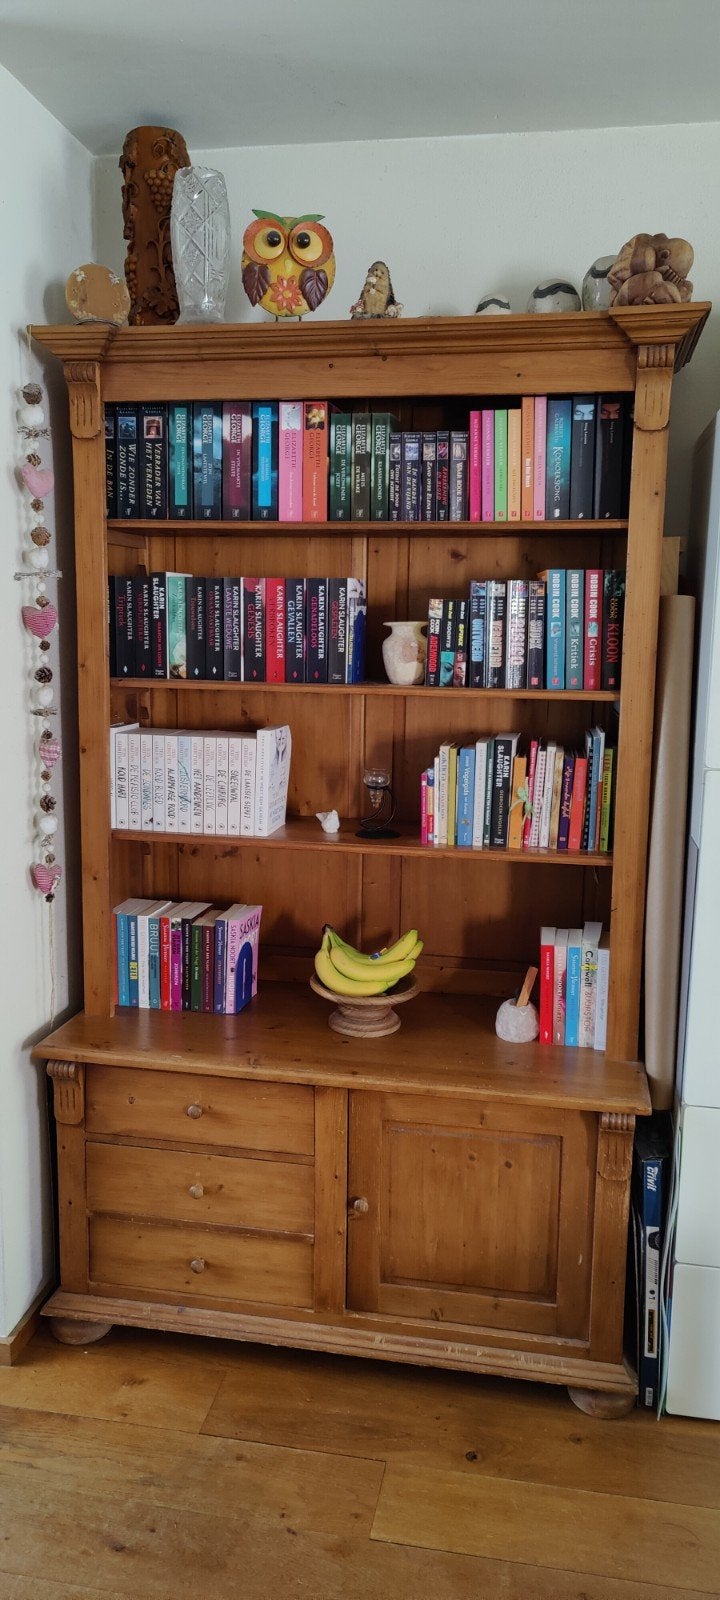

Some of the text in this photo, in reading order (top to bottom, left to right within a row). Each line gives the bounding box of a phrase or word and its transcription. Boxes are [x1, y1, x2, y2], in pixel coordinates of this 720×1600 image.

[128, 444, 136, 462] WIE
[154, 443, 162, 486] VERRADER
[107, 464, 113, 476] DE
[406, 477, 411, 486] DE
[552, 574, 560, 618] ROBIN COOK
[571, 574, 579, 598] ROBIN
[589, 574, 598, 618] ROBIN COOK
[472, 619, 483, 662] ONTVOERD
[530, 620, 542, 649] SHOCK
[606, 624, 619, 662] KLOON
[429, 636, 437, 672] ADEMNOOD
[570, 638, 578, 669] Kritiek
[193, 769, 201, 779] HET
[496, 745, 504, 787] SLAUGHTER
[118, 784, 126, 798] HART
[150, 924, 159, 956] BRUUT
[584, 951, 593, 987] Cornwell
